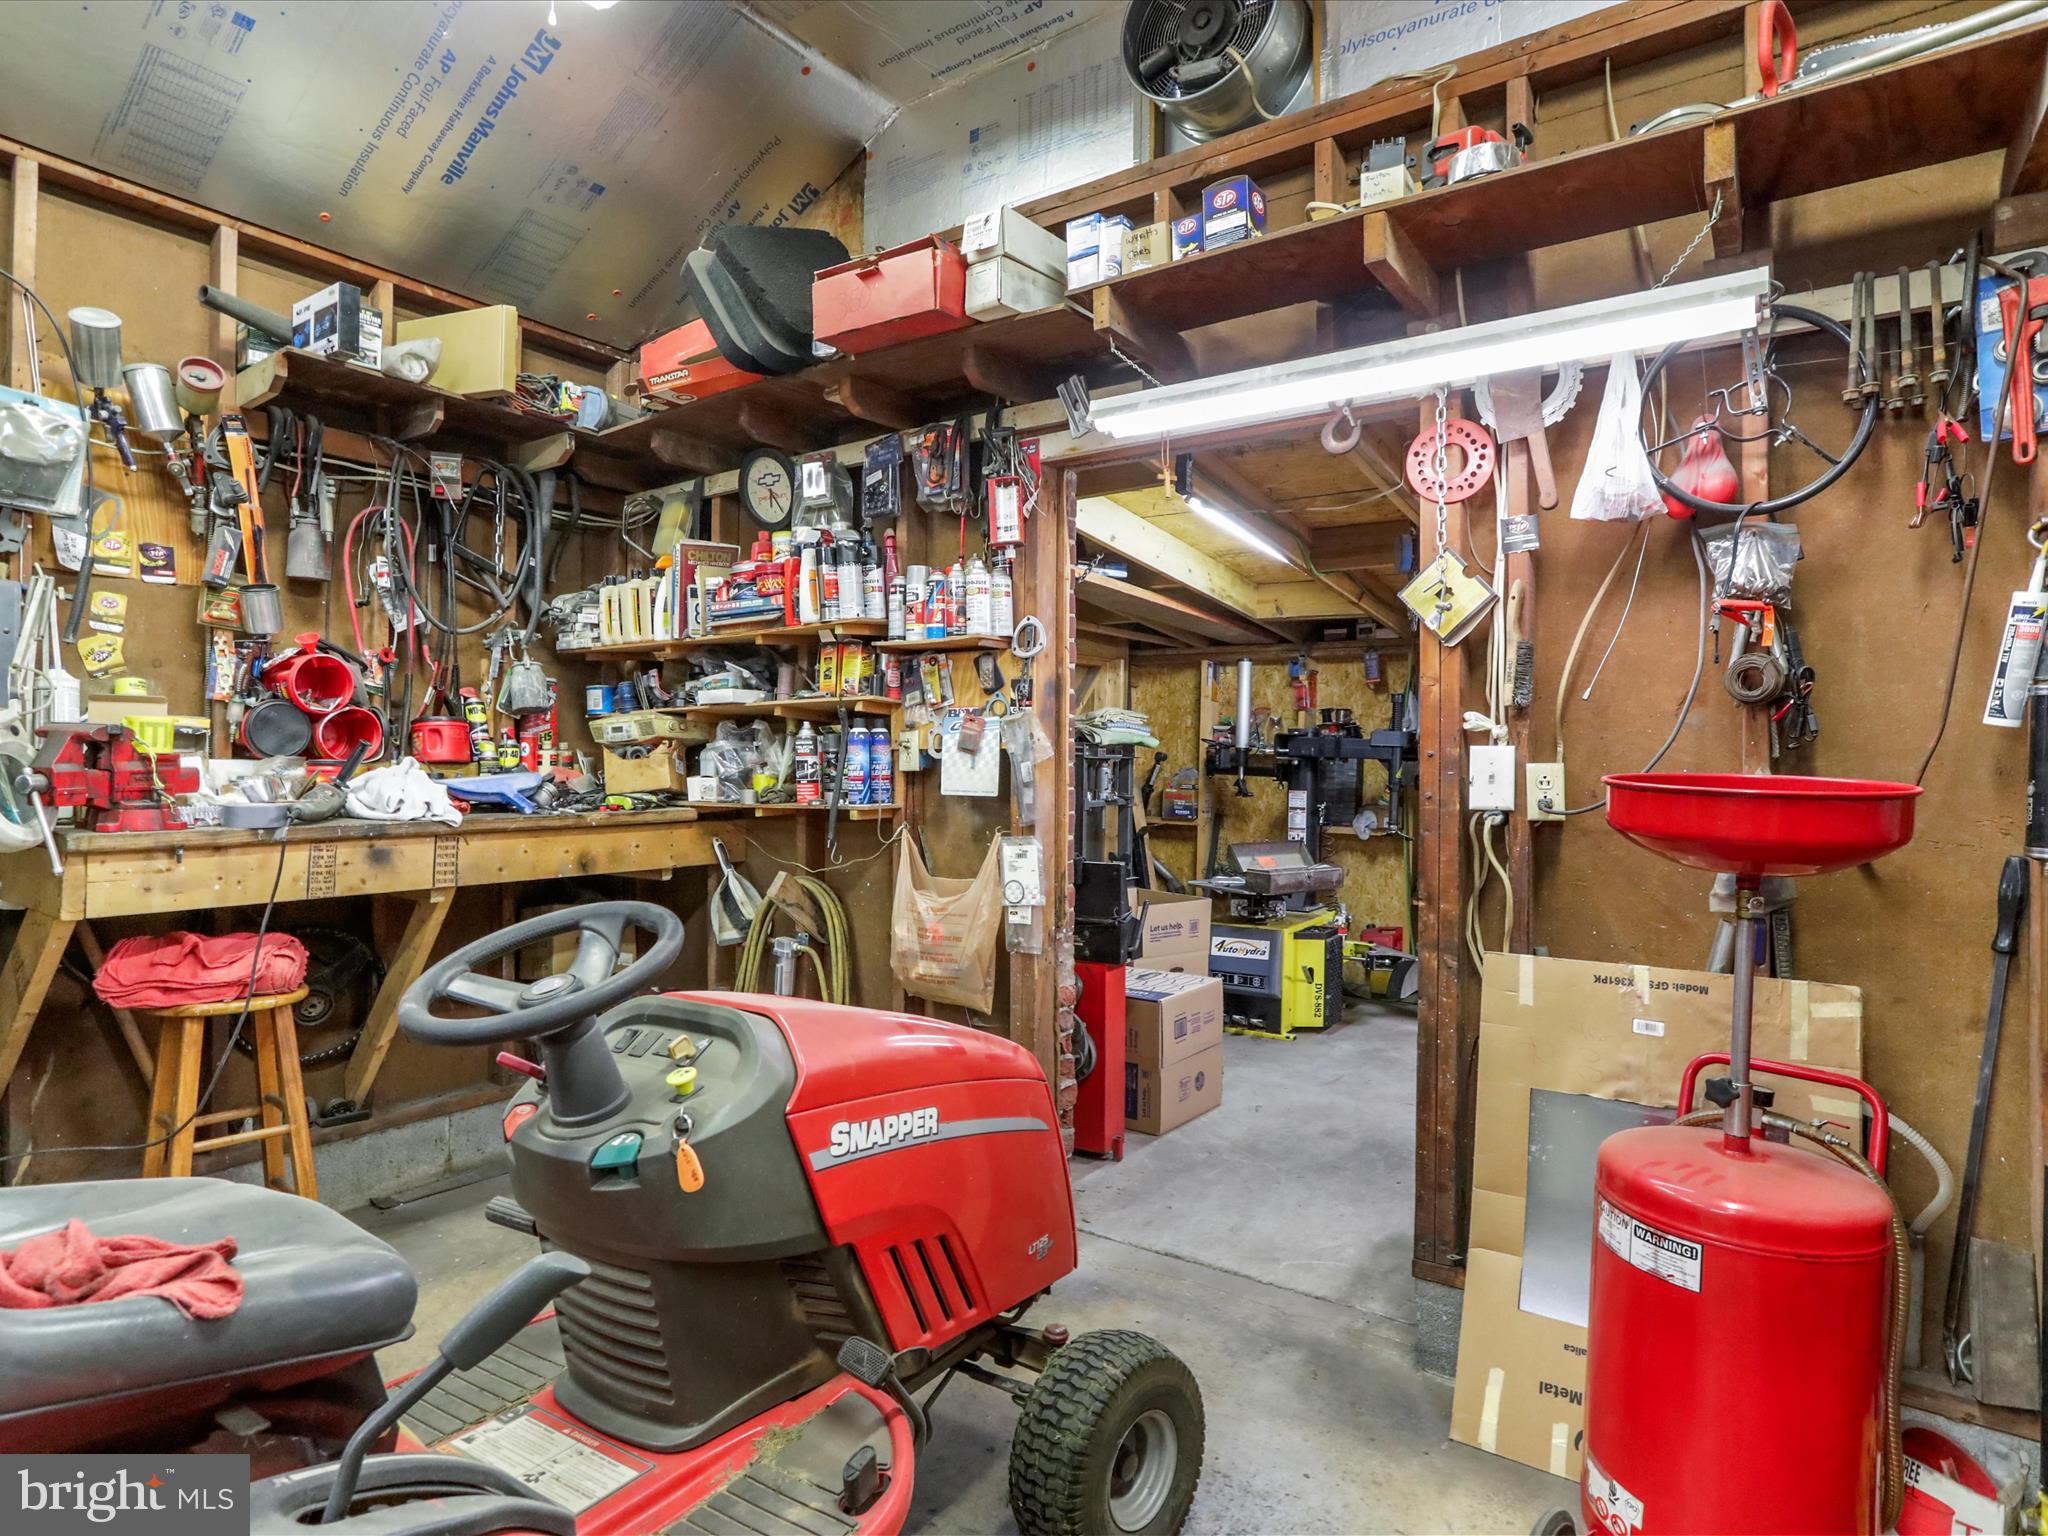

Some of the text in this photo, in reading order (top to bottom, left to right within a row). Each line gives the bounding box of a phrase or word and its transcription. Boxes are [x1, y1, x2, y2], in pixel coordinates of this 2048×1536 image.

[877, 3, 1003, 69] Continuous Insulation
[956, 13, 1019, 46] Foil-Faced
[1019, 14, 1065, 40] Berkshire
[972, 33, 1019, 60] Hathaway
[458, 65, 492, 110] Berkshire
[485, 64, 527, 118] Johns
[372, 72, 421, 142] Continuous
[396, 75, 442, 139] Foil-Faced
[427, 108, 464, 154] Hathaway
[440, 116, 495, 185] Manville
[338, 142, 380, 197] Insulation
[401, 154, 434, 195] Company
[1215, 191, 1235, 207] STP
[1179, 219, 1195, 233] STP
[648, 369, 689, 385] TRANSTAR
[105, 539, 121, 549] STP
[687, 550, 732, 561] CHILTON
[1150, 925, 1160, 933] Let
[1169, 922, 1184, 931] help.
[1314, 983, 1323, 1018] DVS-882
[1673, 983, 1709, 995] Model:
[829, 1107, 938, 1157] SNAPPER
[1635, 1226, 1697, 1259] WARNING!
[1538, 1381, 1583, 1406] Metal
[569, 1430, 601, 1448] DANGER
